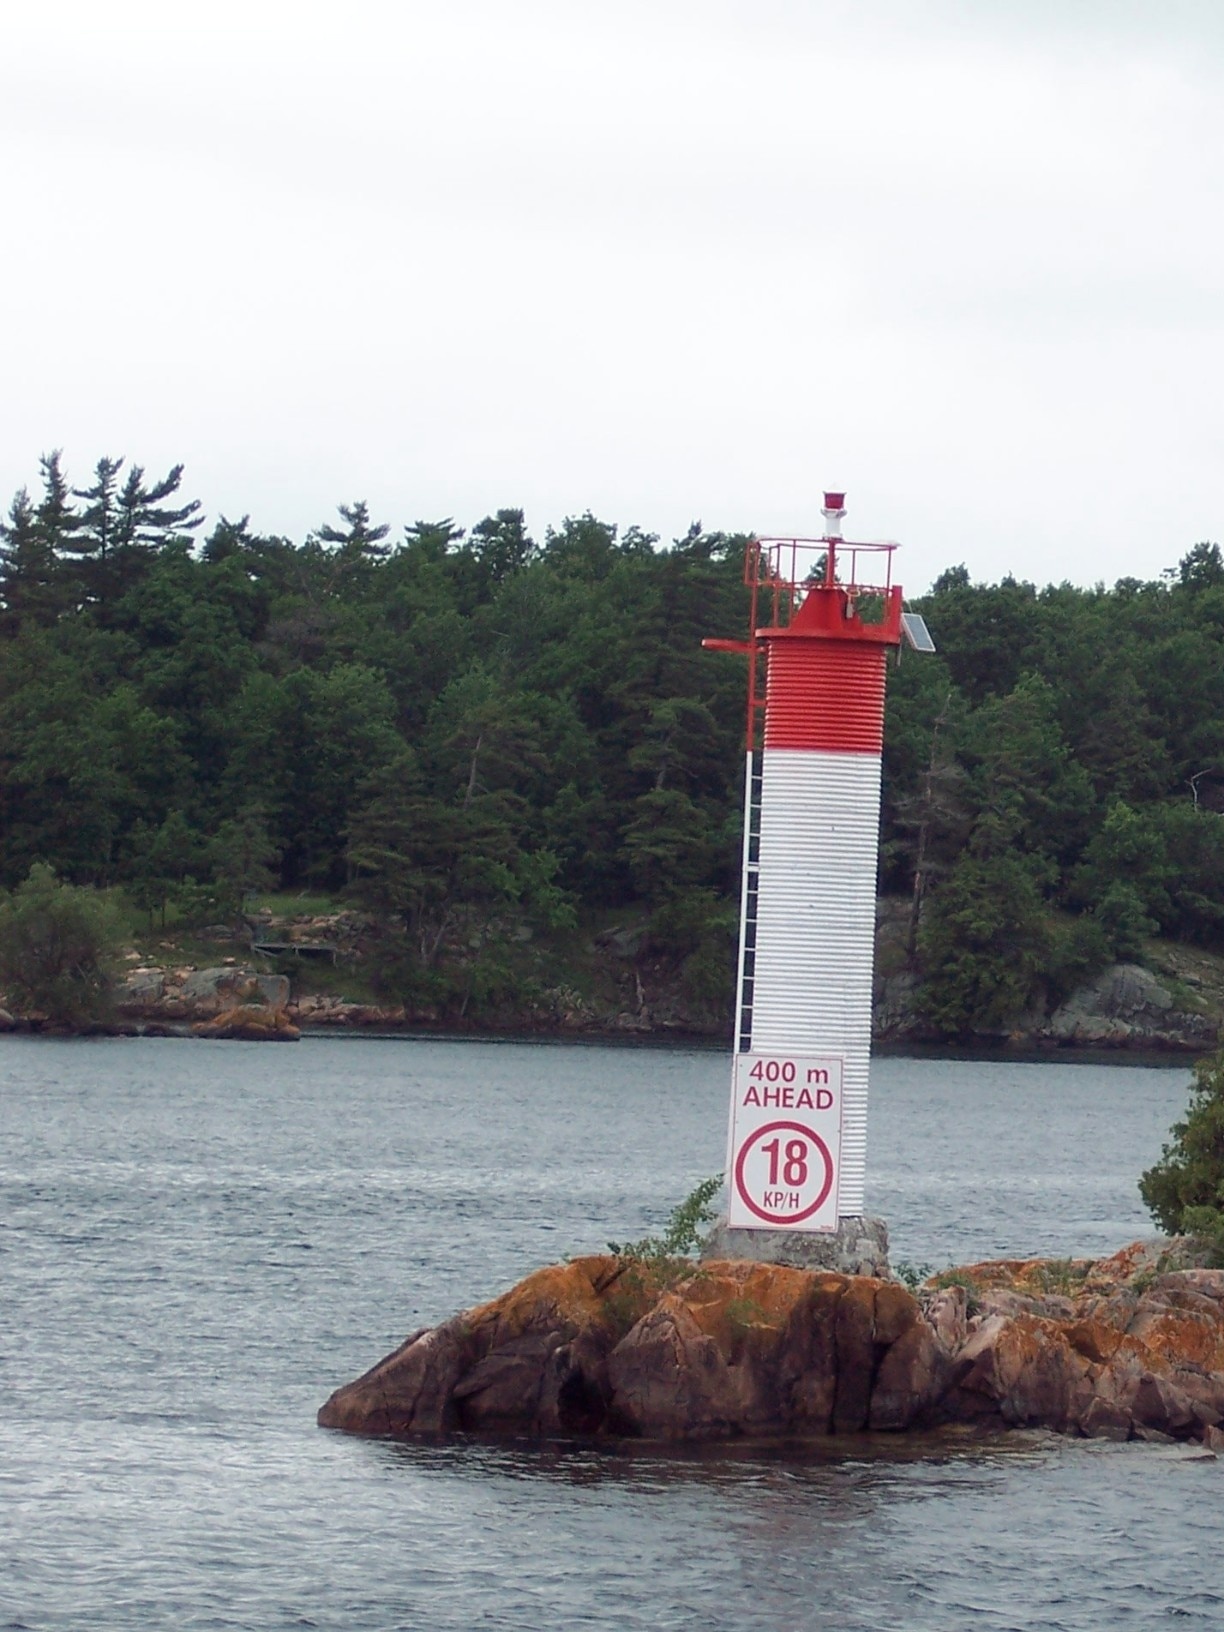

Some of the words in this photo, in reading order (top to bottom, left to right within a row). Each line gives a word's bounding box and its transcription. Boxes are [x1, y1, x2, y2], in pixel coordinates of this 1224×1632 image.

[749, 1060, 796, 1083] 400
[807, 1068, 828, 1084] m
[742, 1086, 833, 1110] AHEAD
[761, 1138, 808, 1187] 18
[763, 1191, 800, 1209] KP/H
